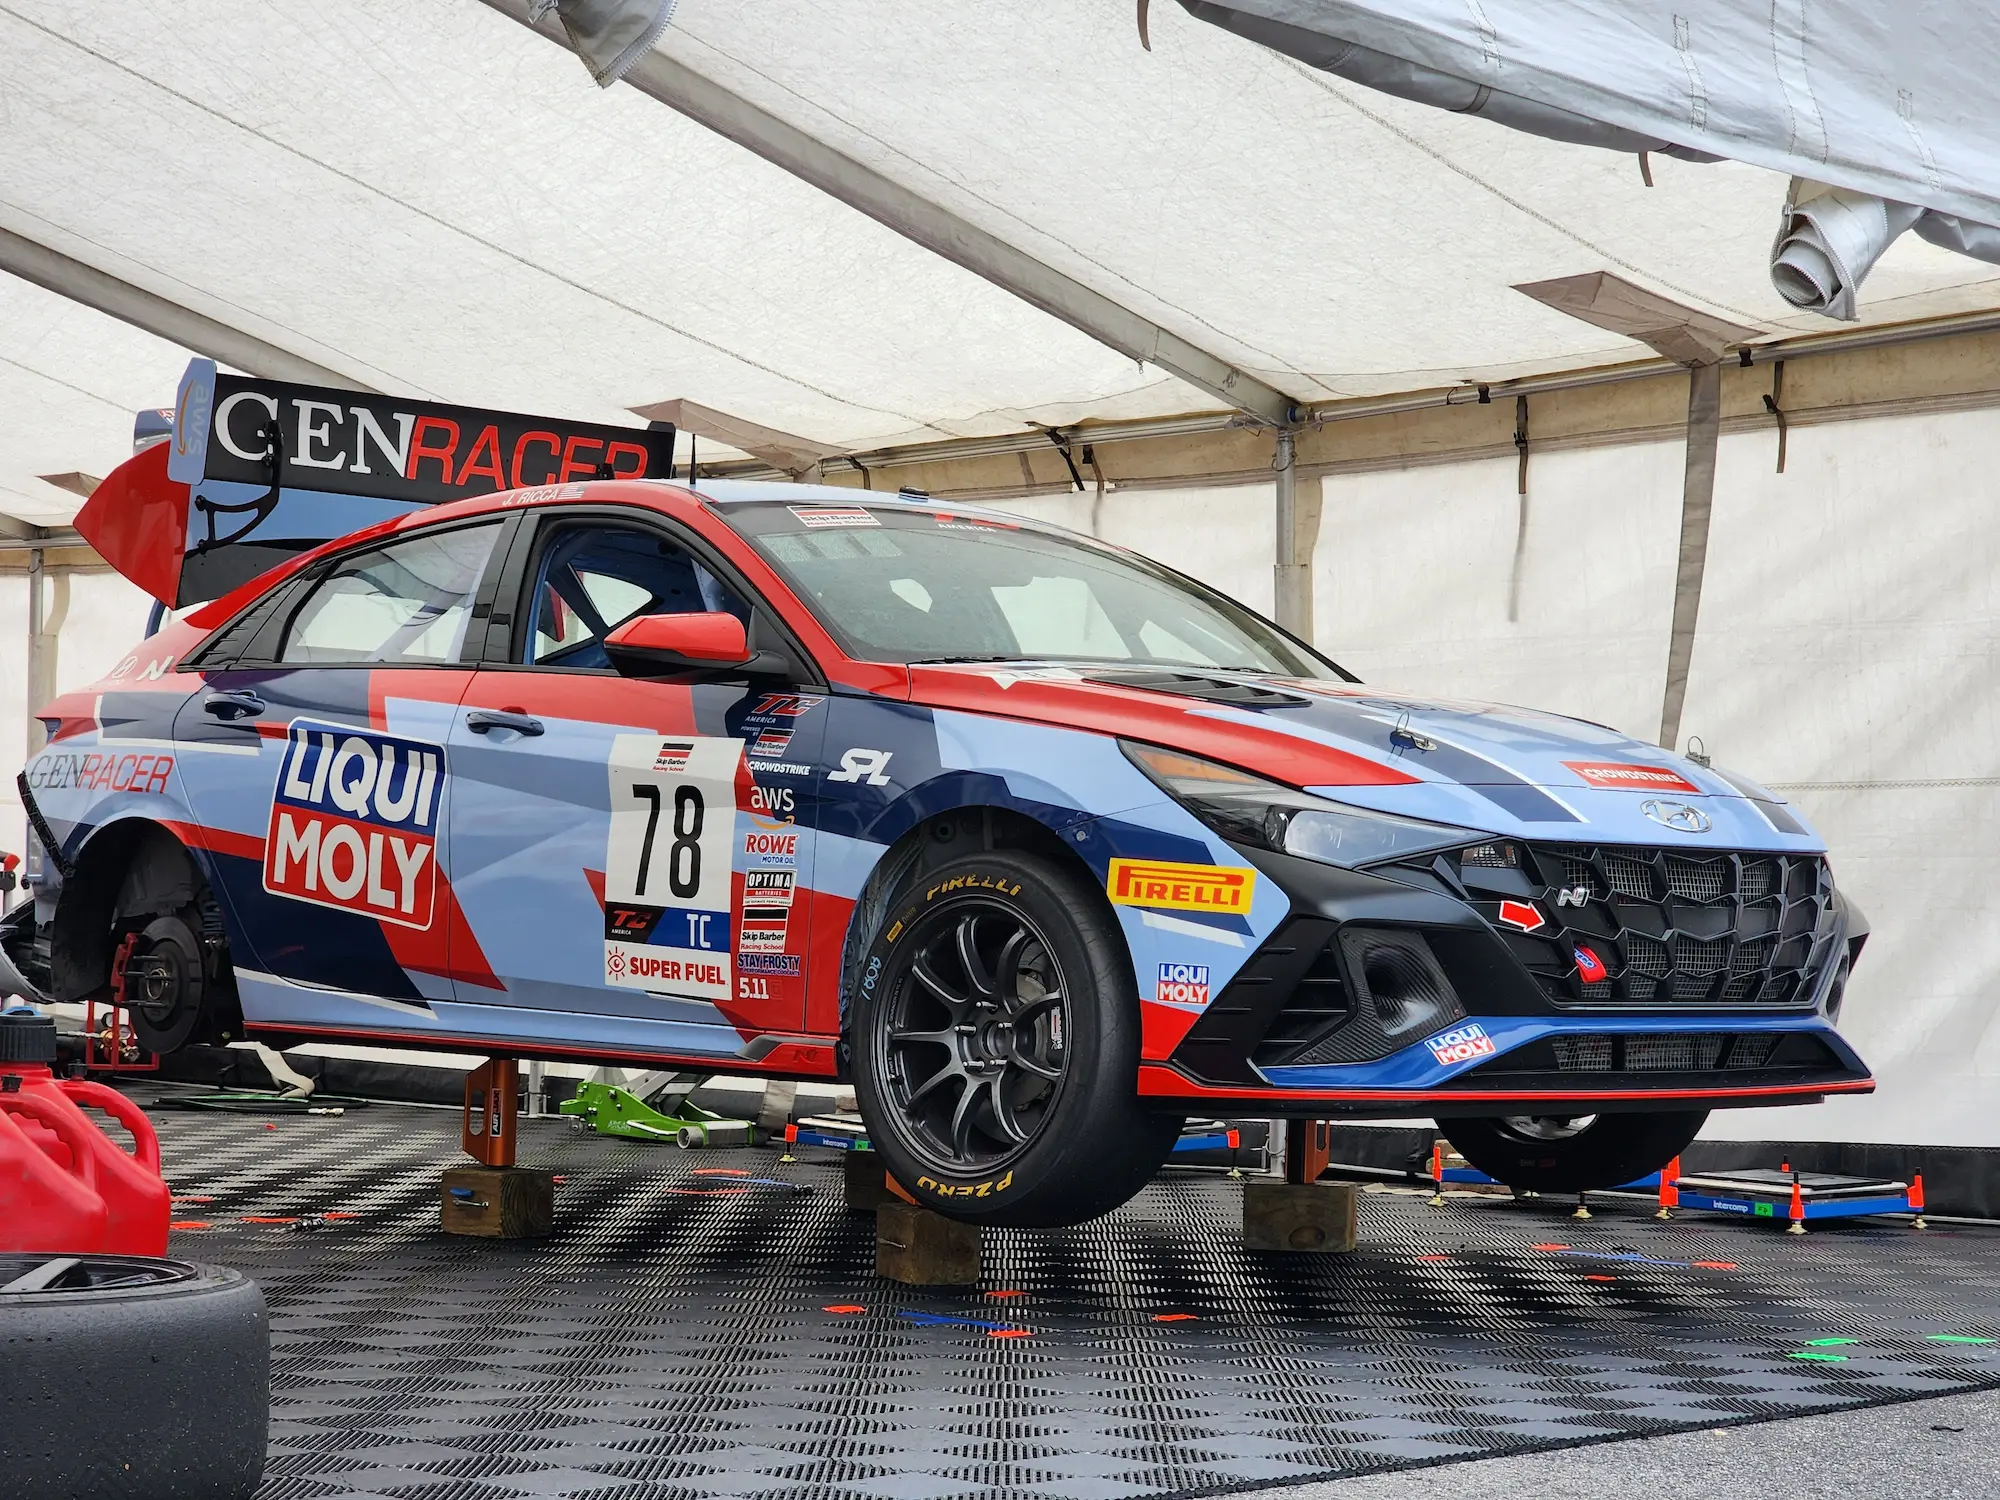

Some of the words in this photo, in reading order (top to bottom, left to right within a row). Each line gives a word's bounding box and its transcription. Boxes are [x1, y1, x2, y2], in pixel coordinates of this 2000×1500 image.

[517, 488, 559, 505] RICCA
[937, 522, 996, 533] AMERICA
[751, 692, 826, 717] TC
[745, 716, 776, 724] AMERICA
[655, 758, 667, 766] Skip
[748, 761, 811, 776] CROWDSTRIKE
[30, 754, 174, 794] GENRACER
[284, 728, 437, 827] LIQUI
[1583, 768, 1686, 784] CROWDSTRIKE
[751, 785, 795, 812] aws
[632, 783, 704, 899] 78
[745, 833, 796, 855] ROWE
[274, 812, 432, 915] MOLY
[761, 855, 783, 864] MOTOR
[784, 856, 795, 865] OIL
[748, 873, 791, 888] OPTIMA
[927, 873, 1021, 901] PIRELLI
[1116, 865, 1245, 906] PIRELLI
[613, 910, 652, 929] TC
[686, 913, 711, 949] TC
[741, 931, 758, 942] Skip
[759, 931, 785, 941] Barber
[630, 956, 681, 980] SUPER
[685, 962, 726, 985] FUEL
[738, 953, 760, 968] STAY
[762, 954, 800, 971] FROSTY
[1160, 964, 1208, 985] LIQUI
[739, 976, 770, 1000] 5.11
[1159, 983, 1208, 1003] MOLY
[1429, 1025, 1484, 1051] LIQUI
[1438, 1038, 1490, 1063] MOLY
[822, 1138, 848, 1149] Intercomp
[1713, 1199, 1748, 1214] Intercomp
